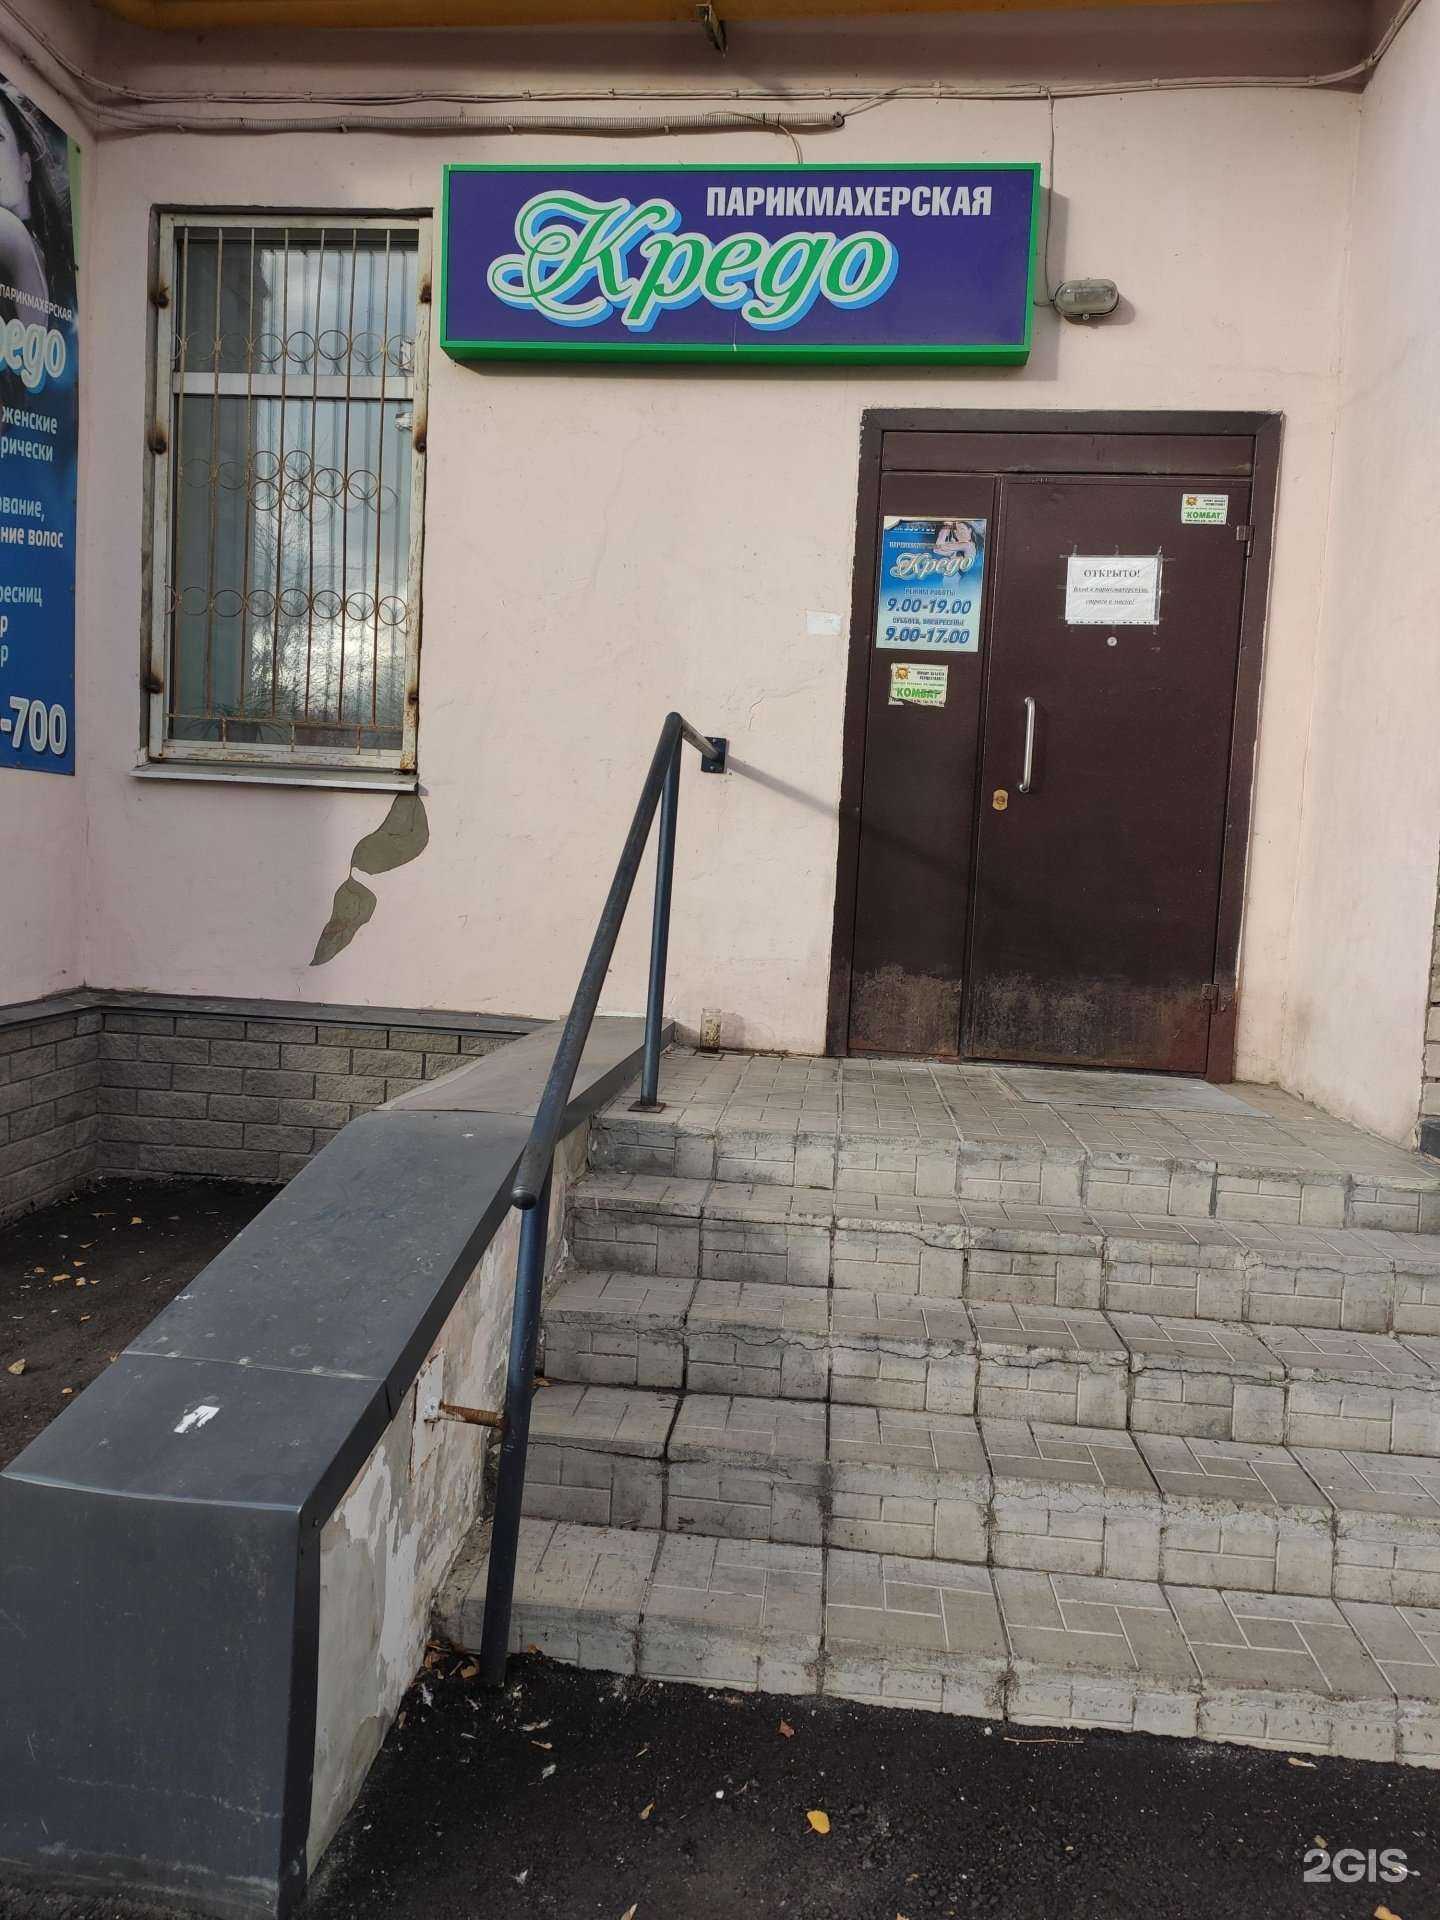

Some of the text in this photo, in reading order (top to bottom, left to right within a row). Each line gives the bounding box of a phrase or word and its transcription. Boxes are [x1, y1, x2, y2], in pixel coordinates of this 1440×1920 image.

[707, 186, 993, 217] ПАРИКМАХЕРСКАЯ
[487, 190, 897, 330] Кредо
[2, 405, 58, 435] женские
[28, 528, 64, 549] волос
[1083, 569, 1141, 578] ОТКРЫТО!
[887, 598, 972, 615] 9.00-19.00
[885, 626, 971, 644] 9.00-17.00
